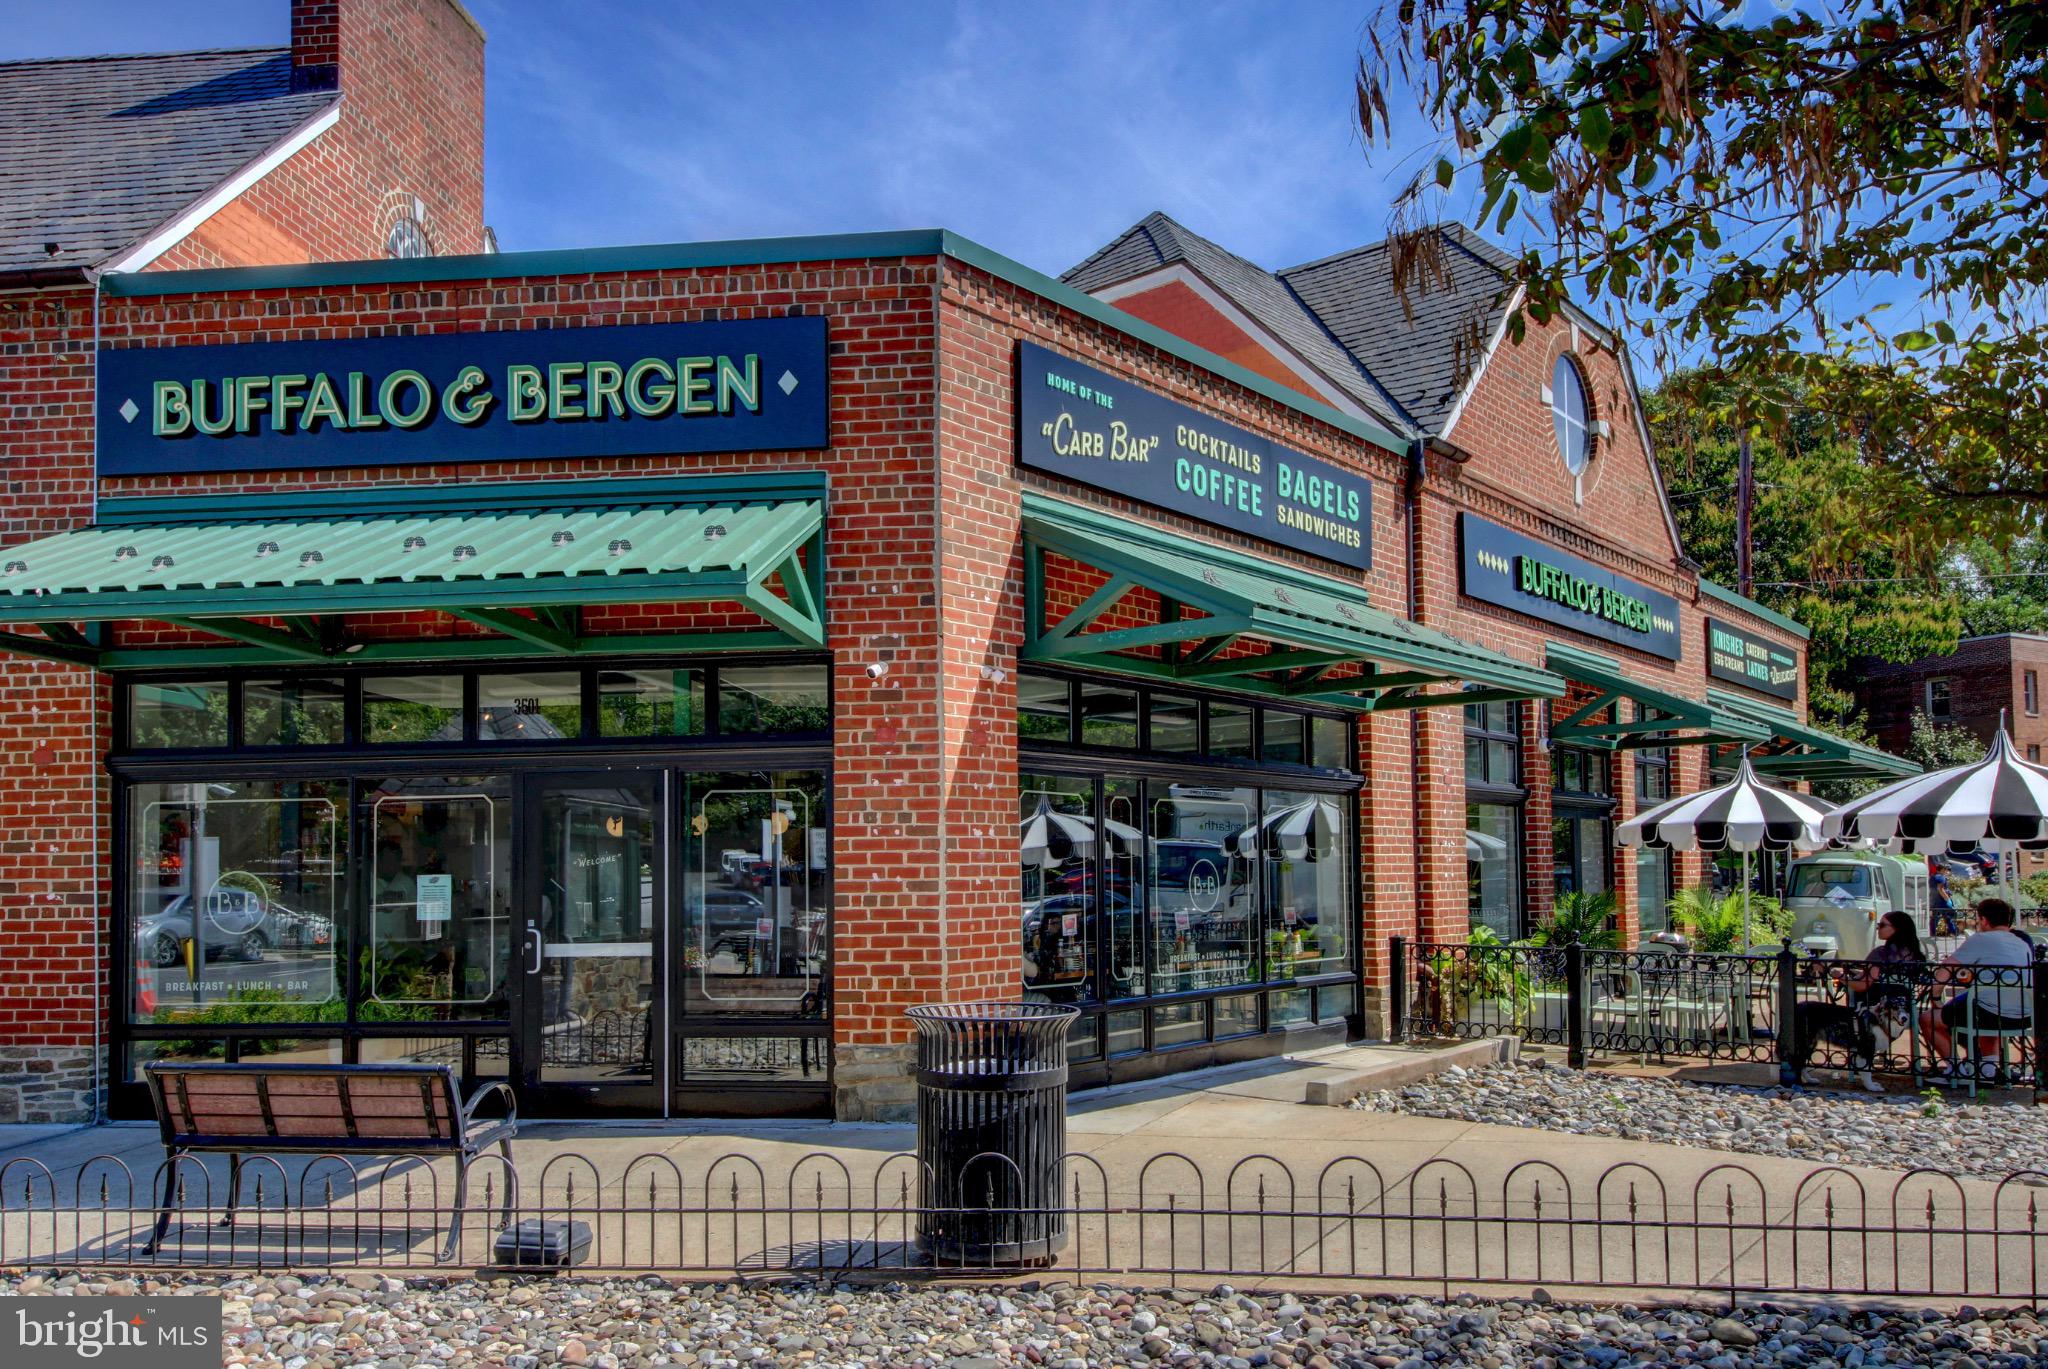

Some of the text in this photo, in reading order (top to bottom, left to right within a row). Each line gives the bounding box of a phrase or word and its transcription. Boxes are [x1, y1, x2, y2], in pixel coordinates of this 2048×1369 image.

[153, 354, 758, 435] BUFFALO & BERGEN
[1047, 372, 1113, 409] HOME OF THE
[1176, 424, 1261, 475] COCKTAILS
[1175, 458, 1263, 517] COFFEE
[1277, 463, 1360, 522] BAGELS
[1277, 504, 1361, 549] SANDWICHES
[1521, 555, 1588, 611] BUFFALO
[1603, 586, 1652, 633] BERGEN
[1713, 628, 1744, 657] KNISHES
[1746, 659, 1769, 682] LATKES
[514, 698, 541, 715] 3501
[1206, 951, 1224, 960] LUNCH
[1229, 949, 1240, 957] BAR
[165, 980, 309, 992] BREAKFAST LUNCH BAR
